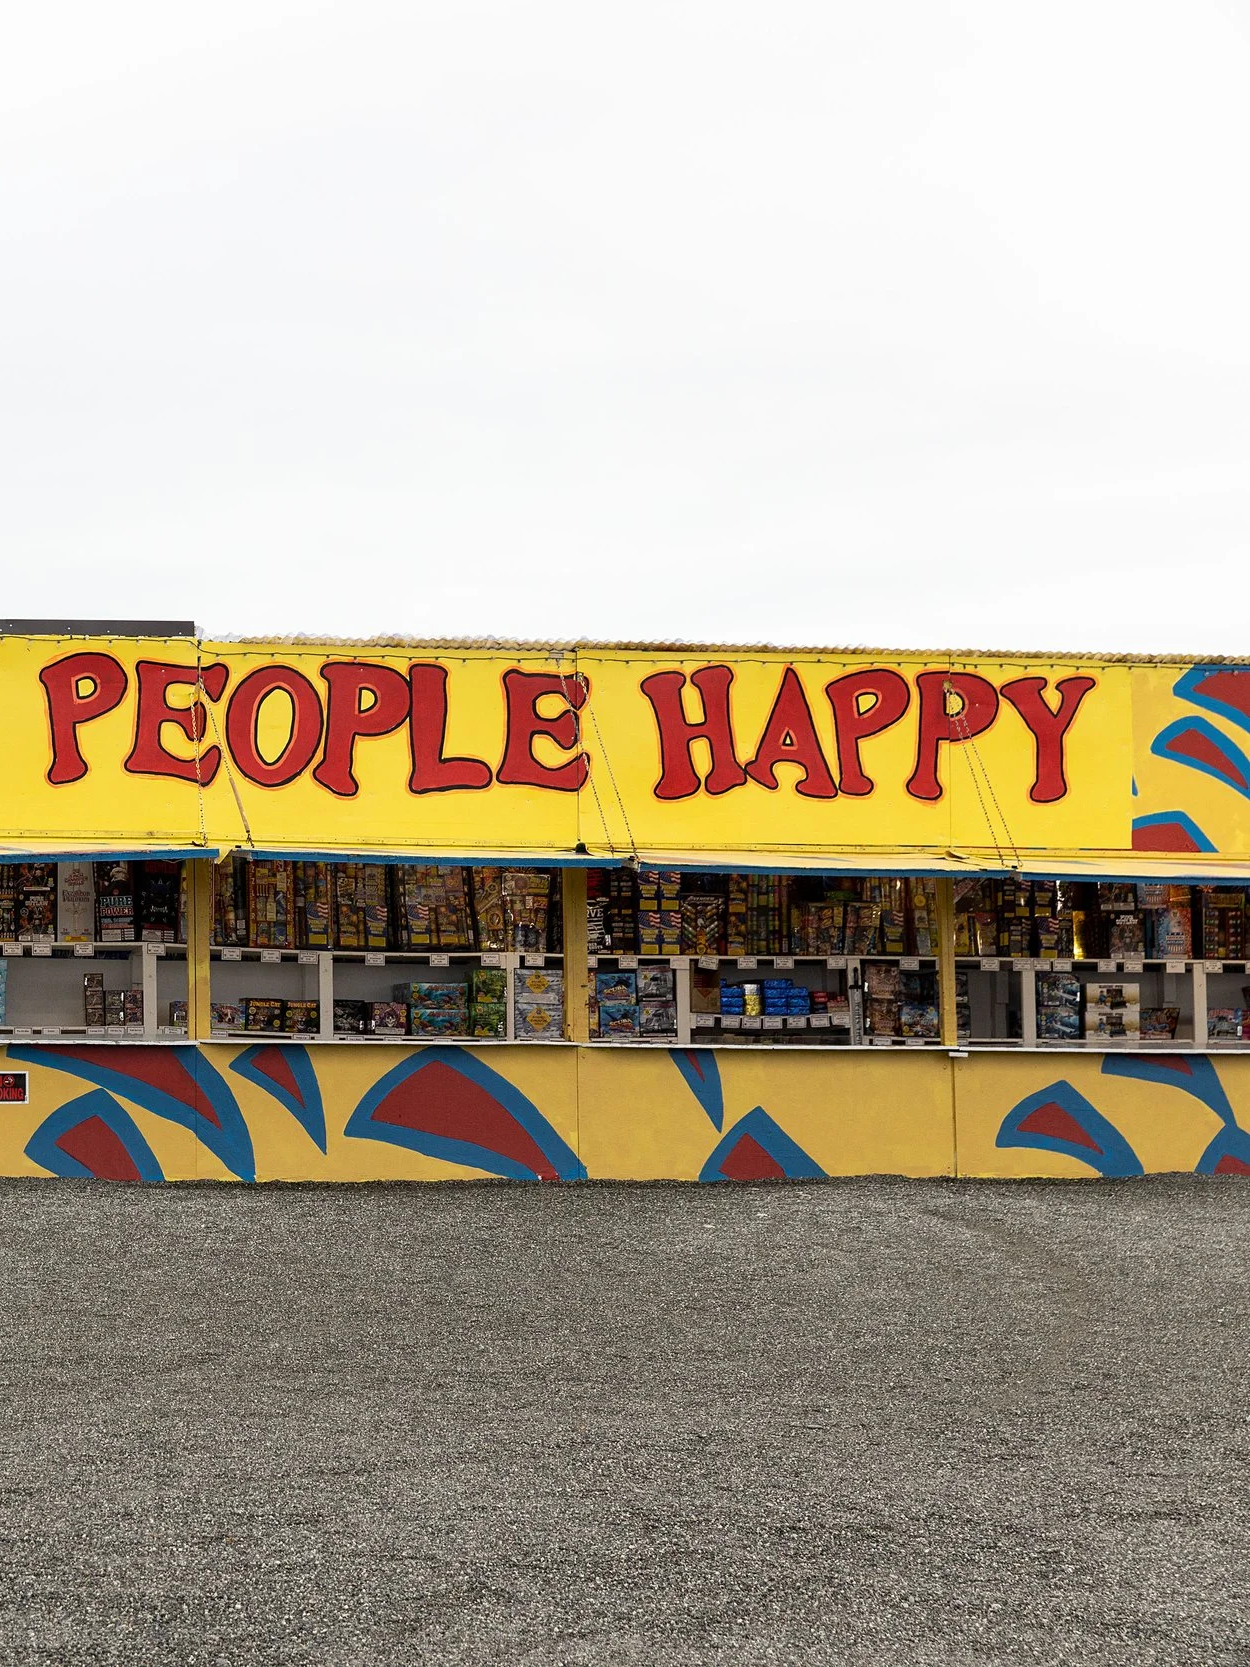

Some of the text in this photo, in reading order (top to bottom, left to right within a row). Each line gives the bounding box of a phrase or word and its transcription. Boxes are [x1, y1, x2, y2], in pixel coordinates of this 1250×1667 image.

[38, 651, 591, 798] PEOPLE
[639, 664, 1097, 804] HAPPY
[100, 896, 133, 907] PURE
[100, 907, 134, 916] POWER
